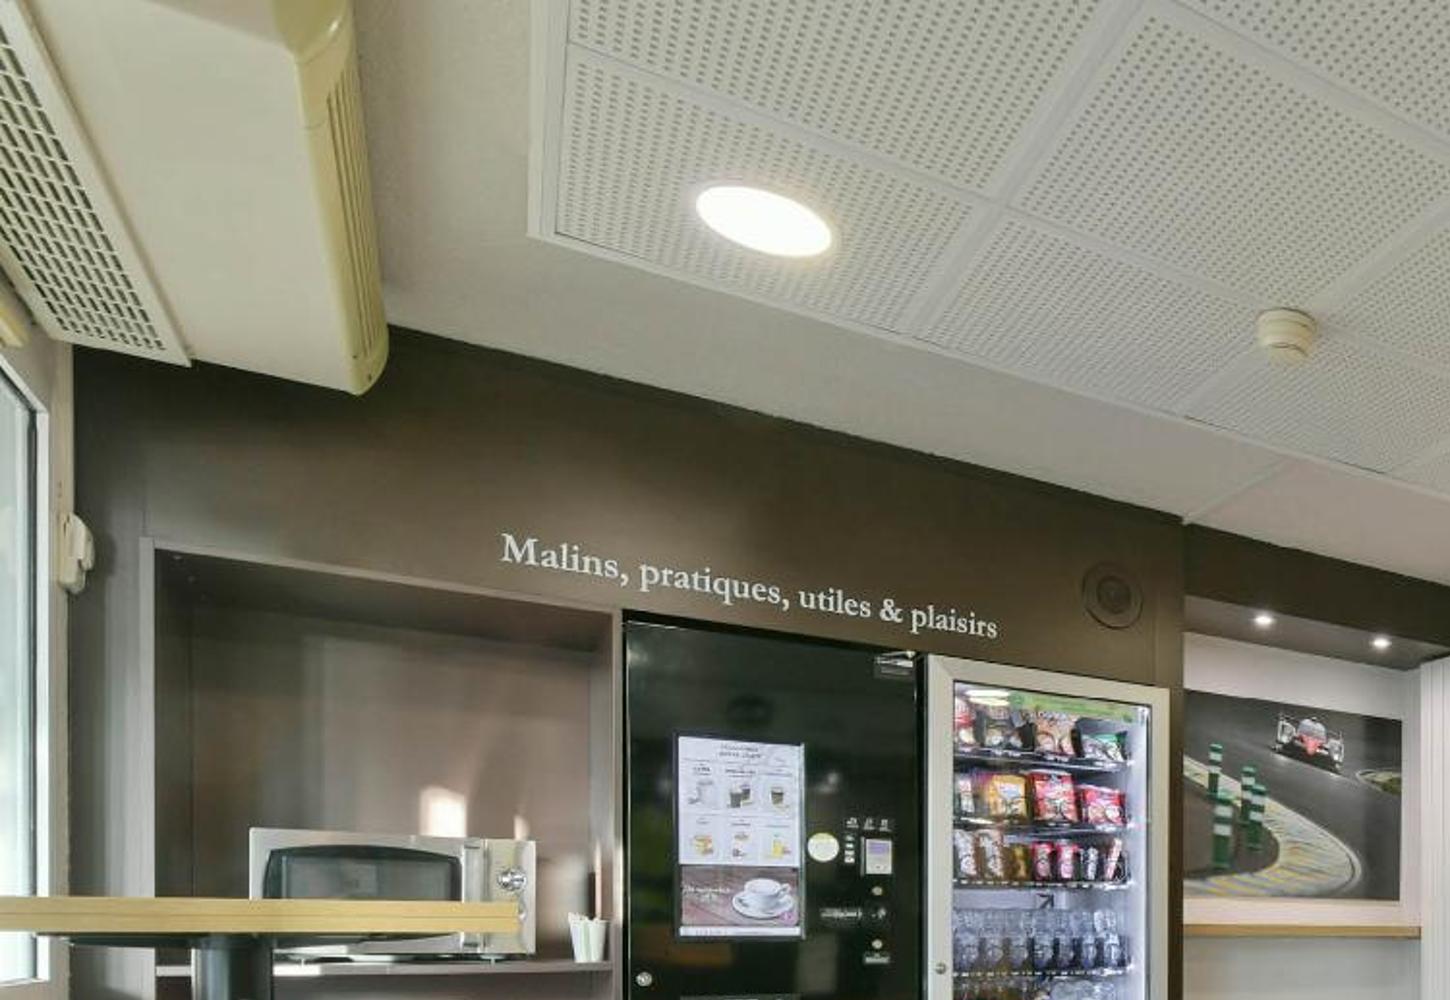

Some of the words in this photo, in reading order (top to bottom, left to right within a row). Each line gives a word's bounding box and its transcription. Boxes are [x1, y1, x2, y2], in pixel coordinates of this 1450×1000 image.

[501, 532, 629, 587] Malins,
[639, 564, 790, 612] pratiques,
[797, 587, 872, 619] utiles
[878, 598, 904, 624] &
[909, 604, 998, 640] plaisirs
